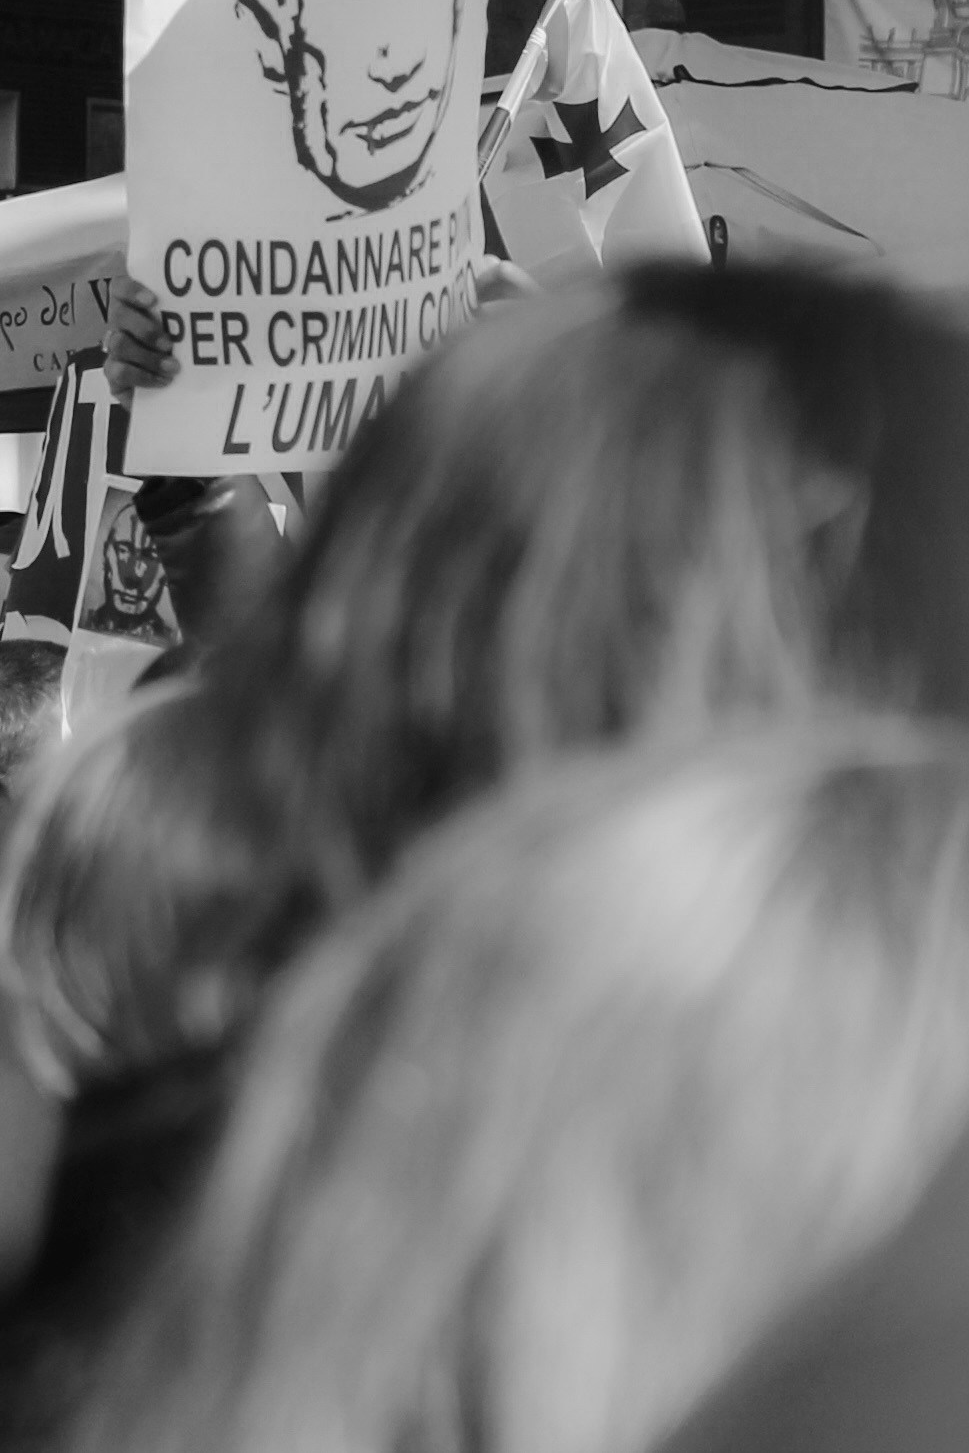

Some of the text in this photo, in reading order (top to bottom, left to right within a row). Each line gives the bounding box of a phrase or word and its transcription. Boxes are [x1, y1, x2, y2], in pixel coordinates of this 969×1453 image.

[163, 218, 442, 297] CONDANNARE
[40, 282, 76, 326] del
[160, 310, 252, 366] PER
[267, 298, 408, 367] CRIMINI
[222, 371, 408, 455] L'UMA
